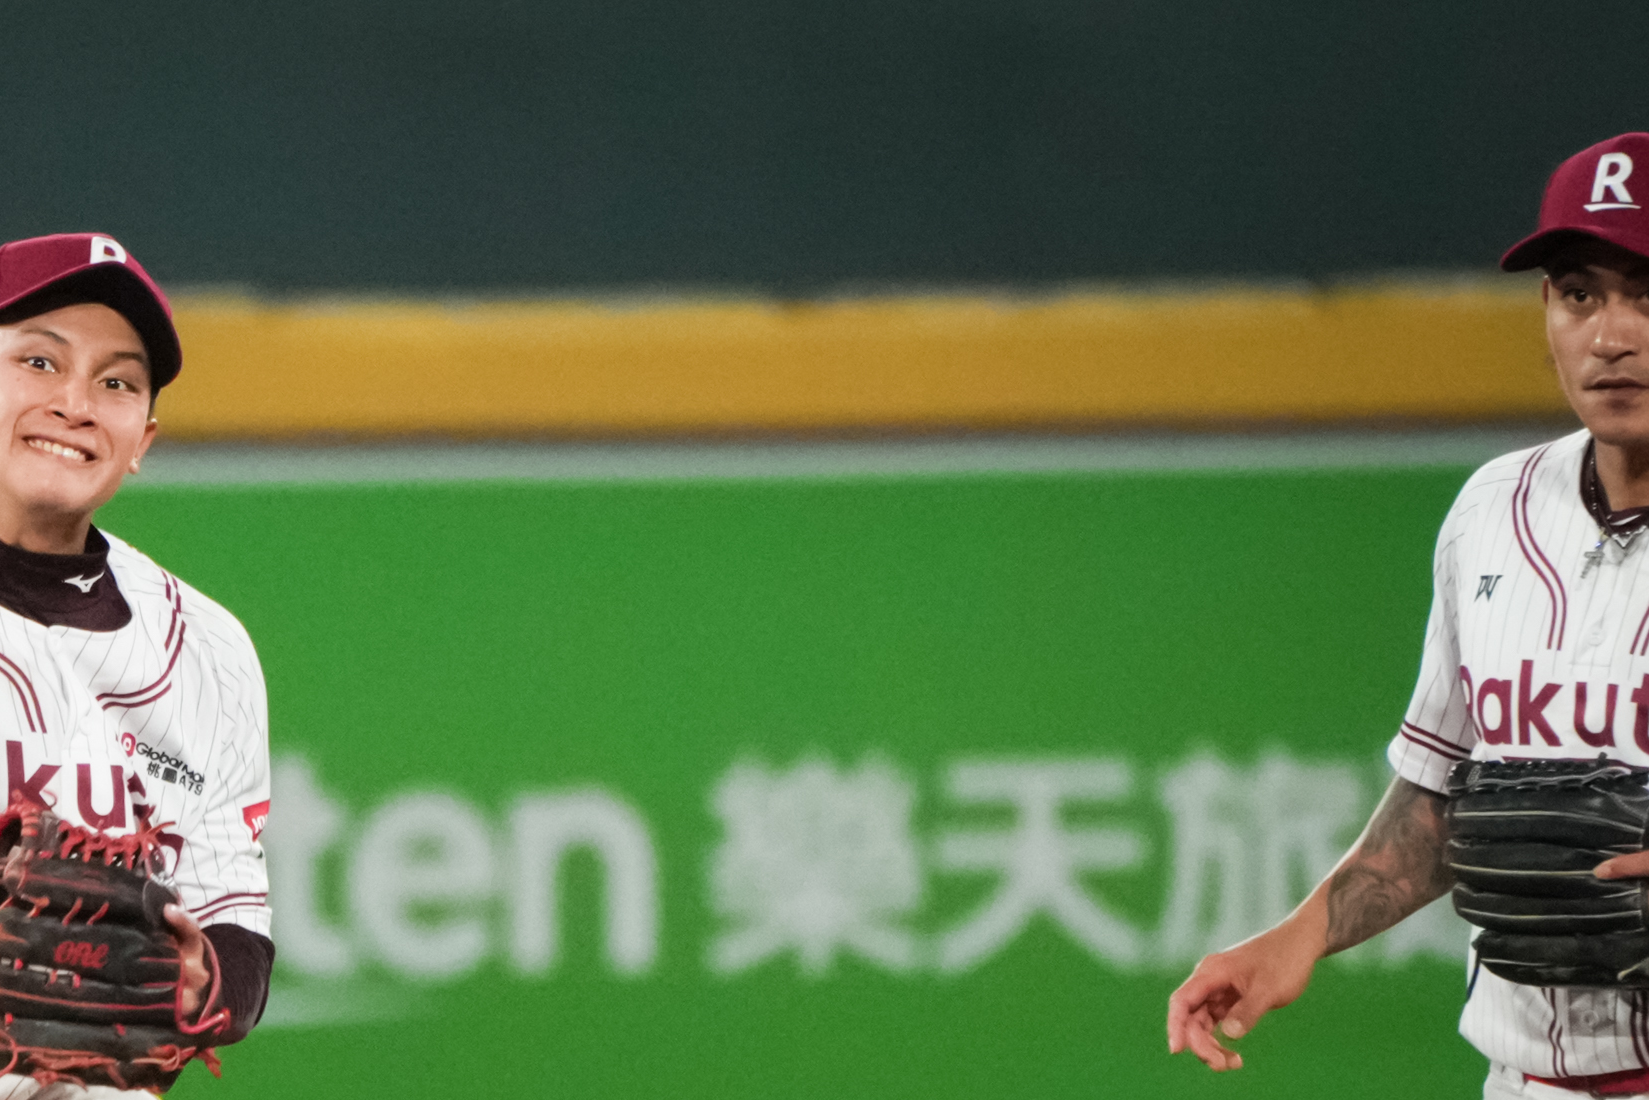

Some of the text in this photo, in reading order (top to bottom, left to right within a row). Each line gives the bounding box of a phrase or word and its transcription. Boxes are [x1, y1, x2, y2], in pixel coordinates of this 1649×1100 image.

[1590, 152, 1634, 203] R
[706, 745, 1475, 978] 樂天旅
